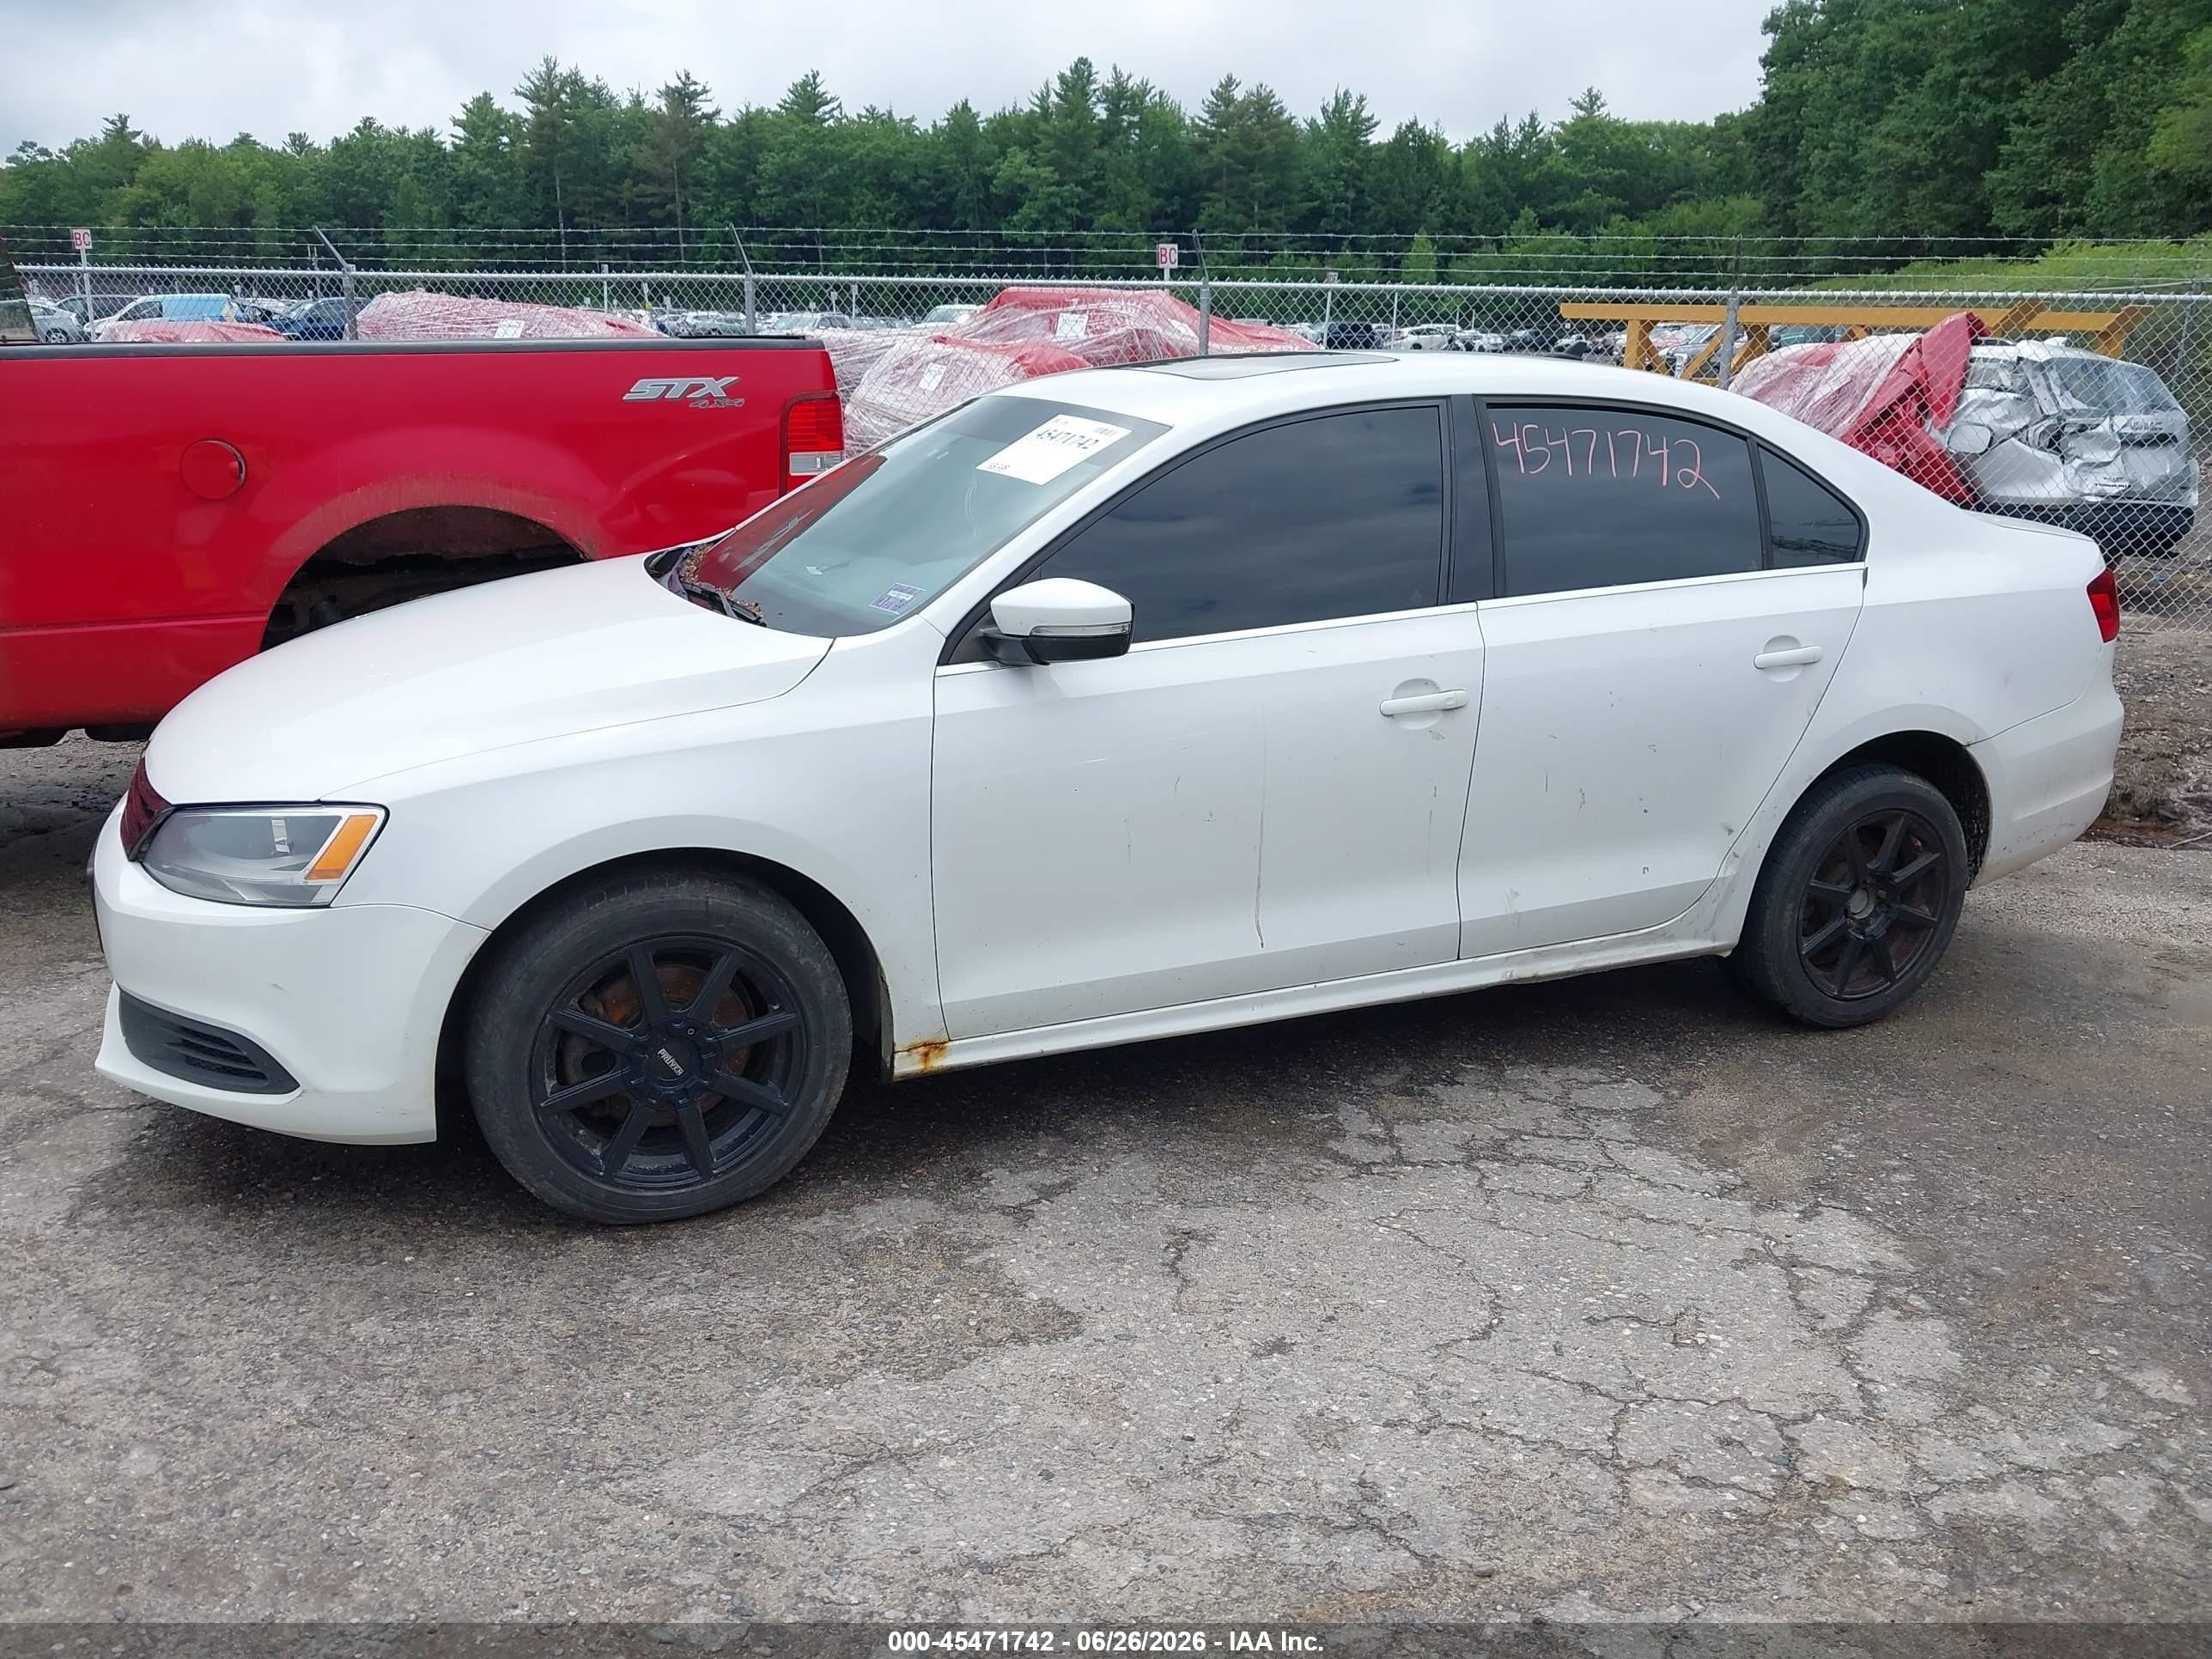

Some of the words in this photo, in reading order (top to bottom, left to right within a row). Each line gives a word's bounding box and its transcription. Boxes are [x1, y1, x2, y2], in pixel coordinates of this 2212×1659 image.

[74, 232, 91, 246] BC
[1159, 246, 1177, 264] BC
[623, 376, 739, 400] STX
[1036, 428, 1101, 450] 45471742
[1492, 422, 1720, 500] 45471742
